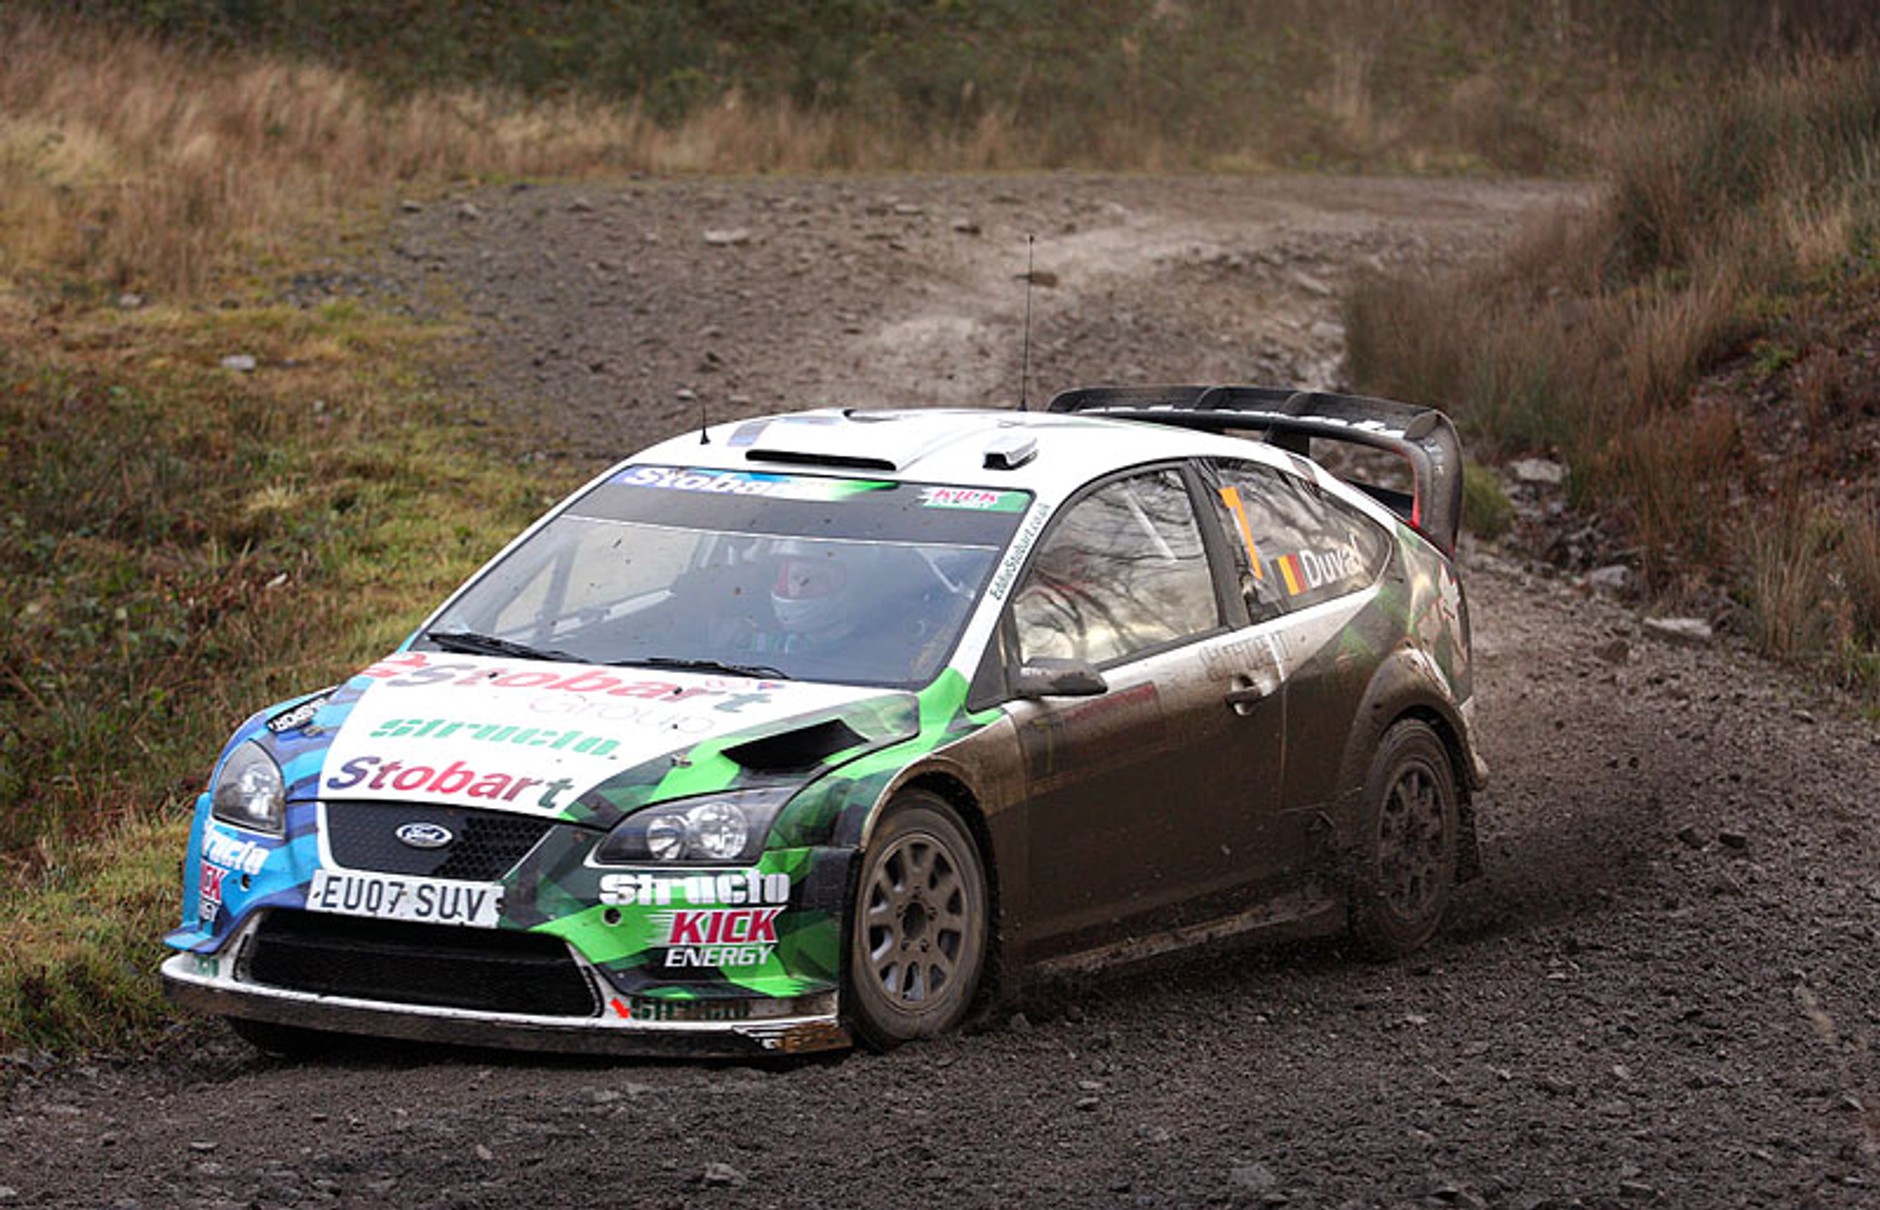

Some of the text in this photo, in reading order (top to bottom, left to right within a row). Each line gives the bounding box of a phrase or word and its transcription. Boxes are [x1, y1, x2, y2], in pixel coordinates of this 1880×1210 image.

[622, 466, 834, 499] Stoba
[1300, 532, 1364, 588] Duval
[386, 661, 774, 714] Stobart
[528, 692, 717, 735] Group
[325, 754, 577, 810] Stobart
[320, 875, 490, 922] EU07 SUV
[668, 909, 780, 944] KICK
[664, 945, 776, 967] ENERGY
